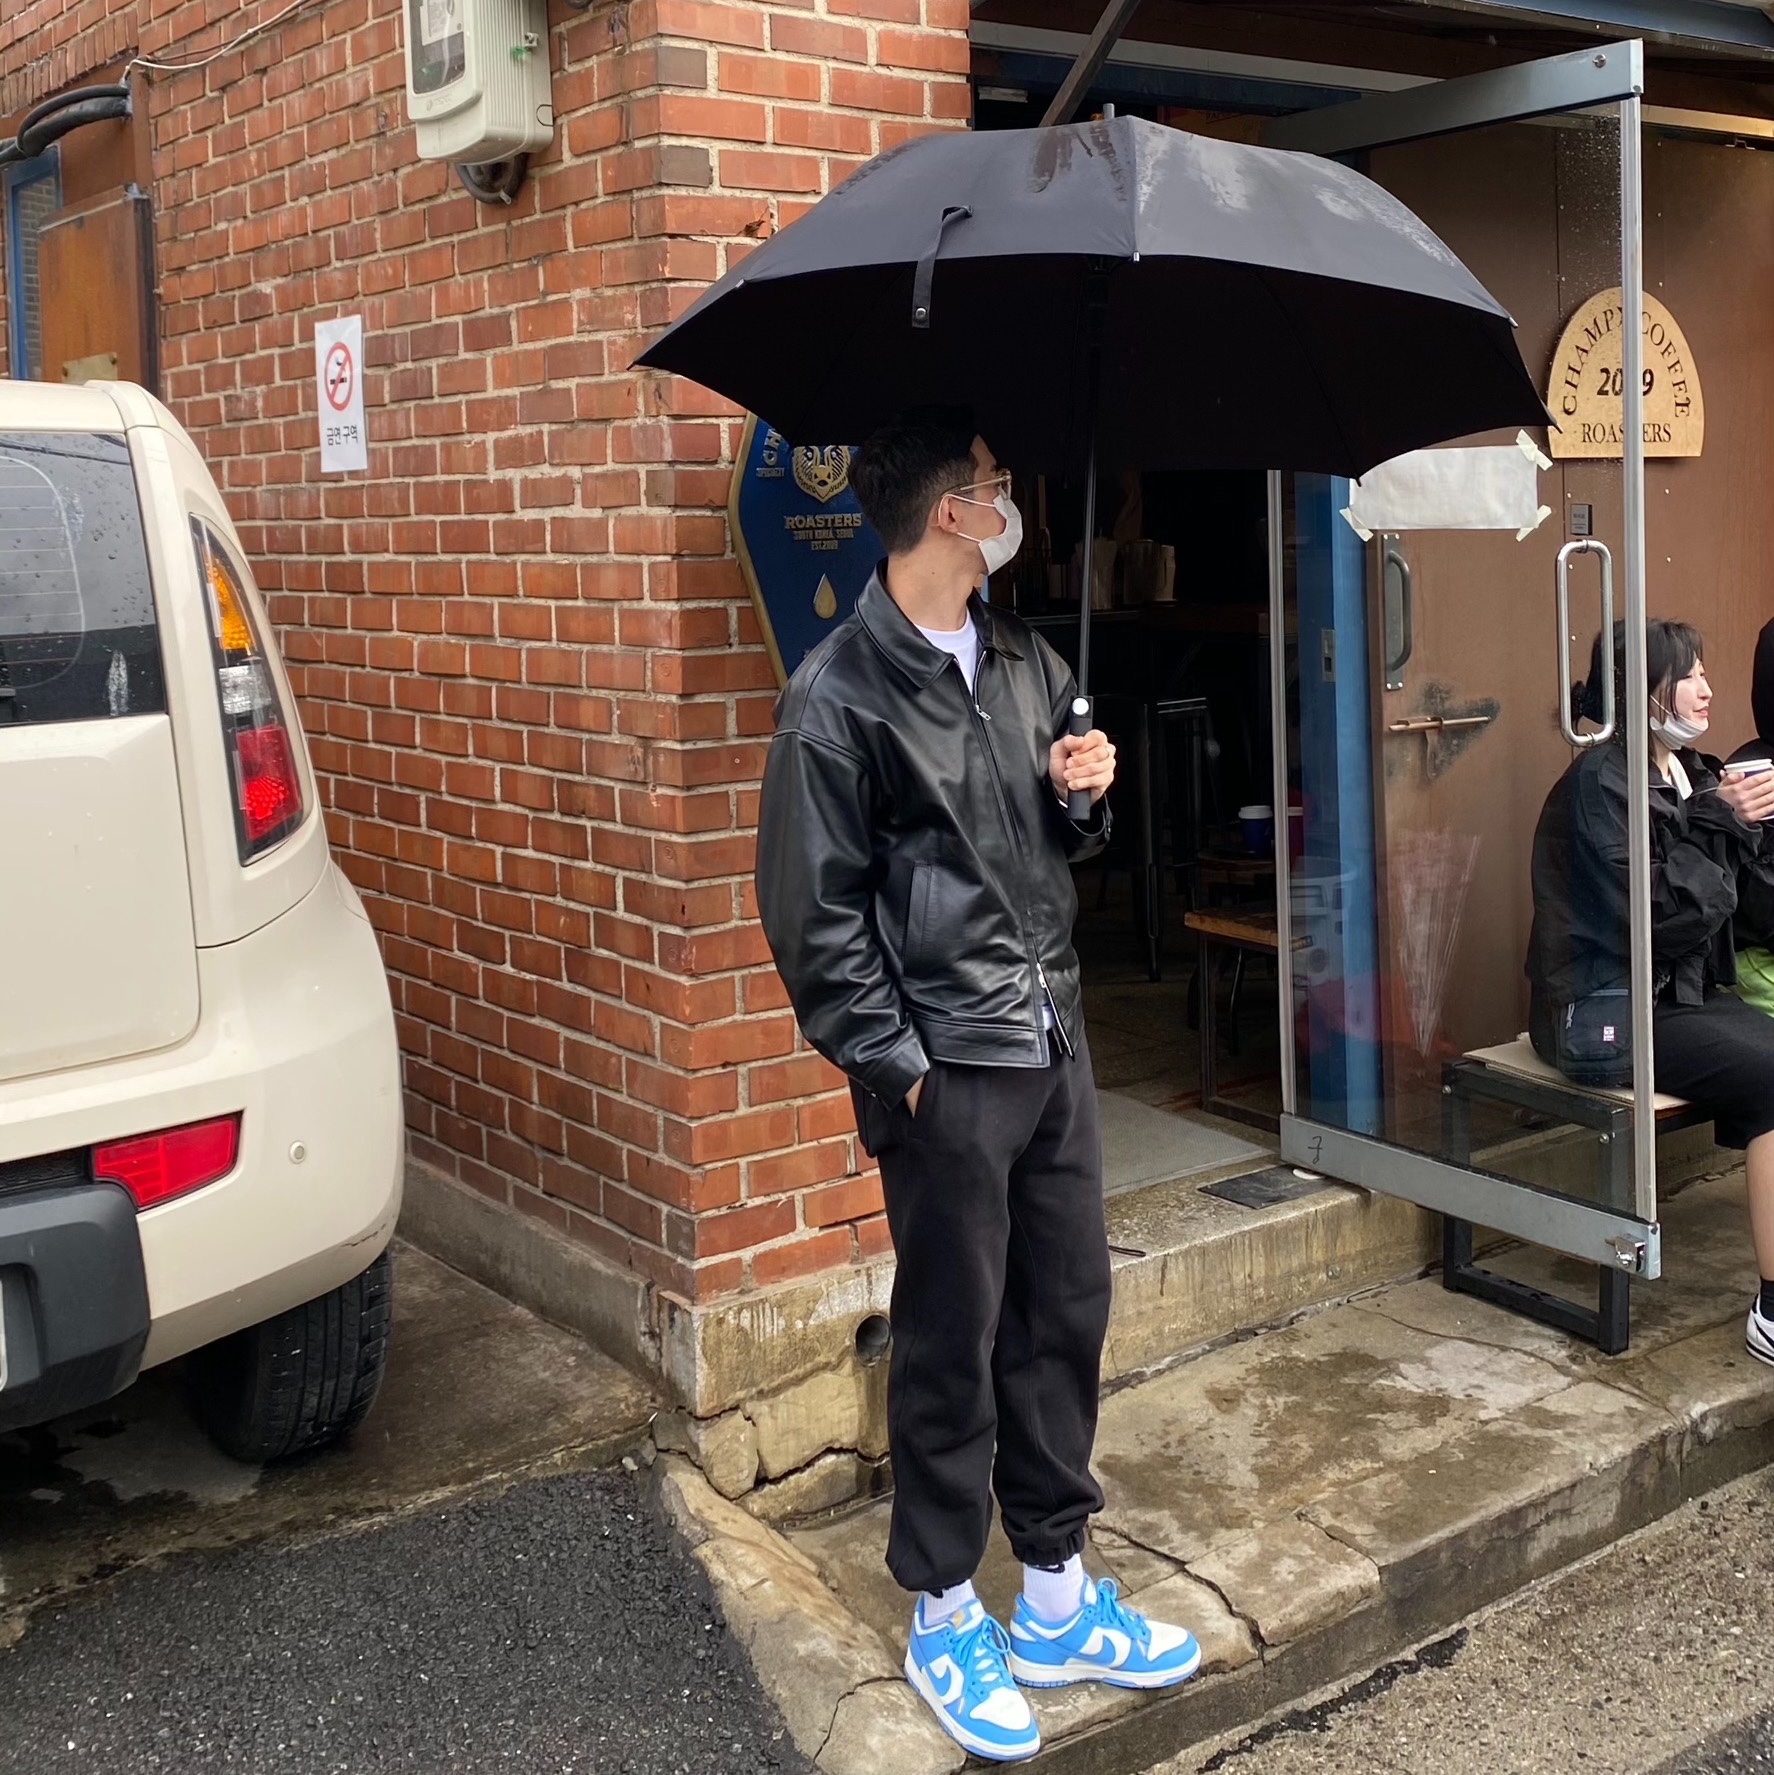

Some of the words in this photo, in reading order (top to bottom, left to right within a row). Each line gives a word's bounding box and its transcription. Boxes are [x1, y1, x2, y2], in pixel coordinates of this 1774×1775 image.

[1642, 311, 1690, 417] COFFEE
[1597, 368, 1655, 396] 209
[326, 427, 341, 446] 금연
[342, 424, 358, 445] 구역
[1582, 423, 1671, 444] ROASERS
[785, 513, 862, 529] ROASTERS
